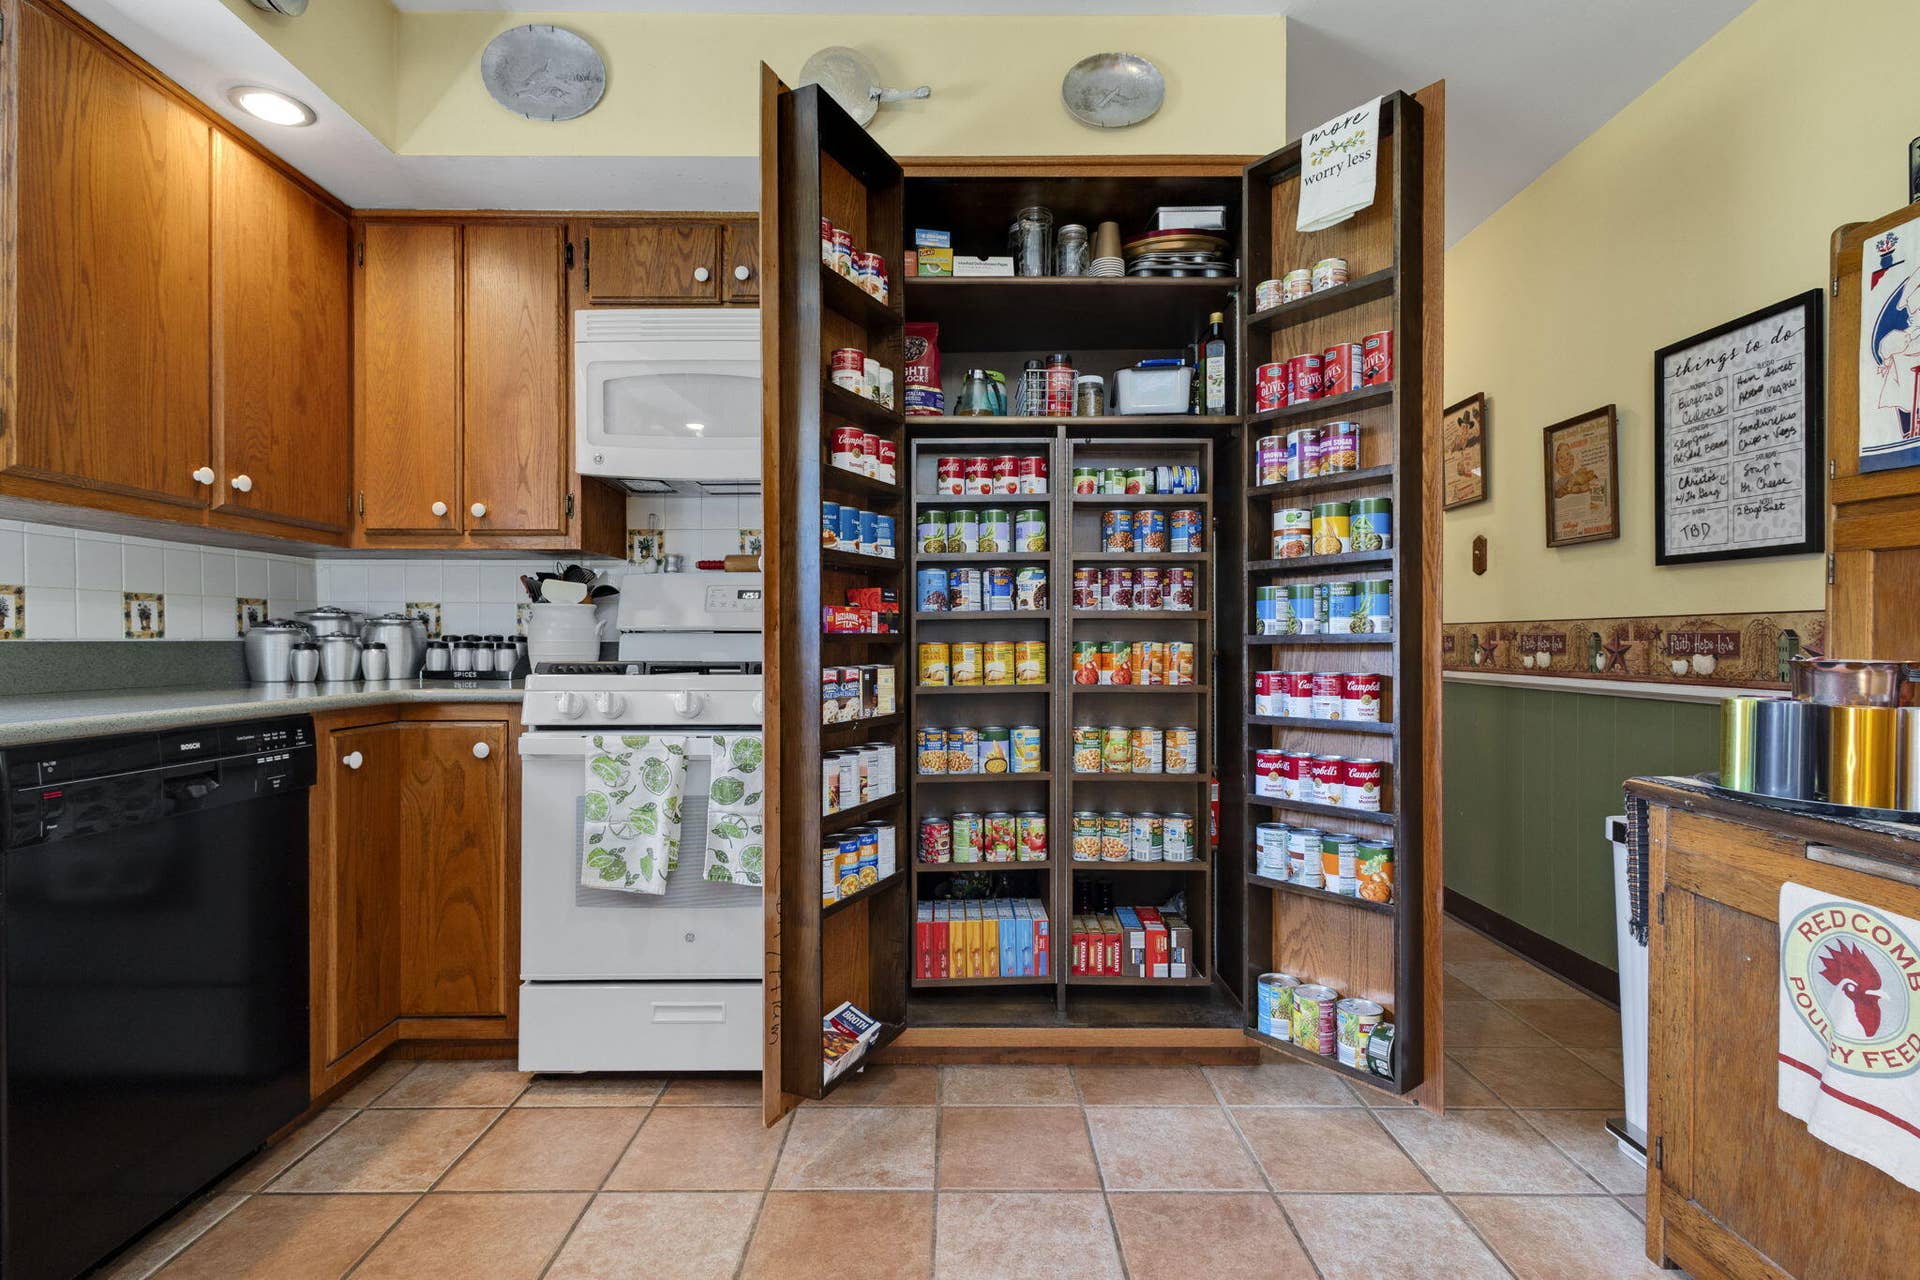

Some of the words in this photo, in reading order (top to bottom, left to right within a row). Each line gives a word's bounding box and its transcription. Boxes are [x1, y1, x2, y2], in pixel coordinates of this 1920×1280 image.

[1308, 112, 1370, 147] more
[1303, 161, 1345, 187] worry
[1347, 149, 1372, 168] less
[1668, 347, 1739, 378] things
[1745, 339, 1765, 354] to
[1770, 325, 1803, 345] do
[1680, 522, 1711, 541] TBD
[1694, 634, 1714, 653] Hope
[180, 742, 200, 751] BOSCH
[842, 1010, 869, 1030] BROTH
[1790, 976, 1854, 1065] POULRY
